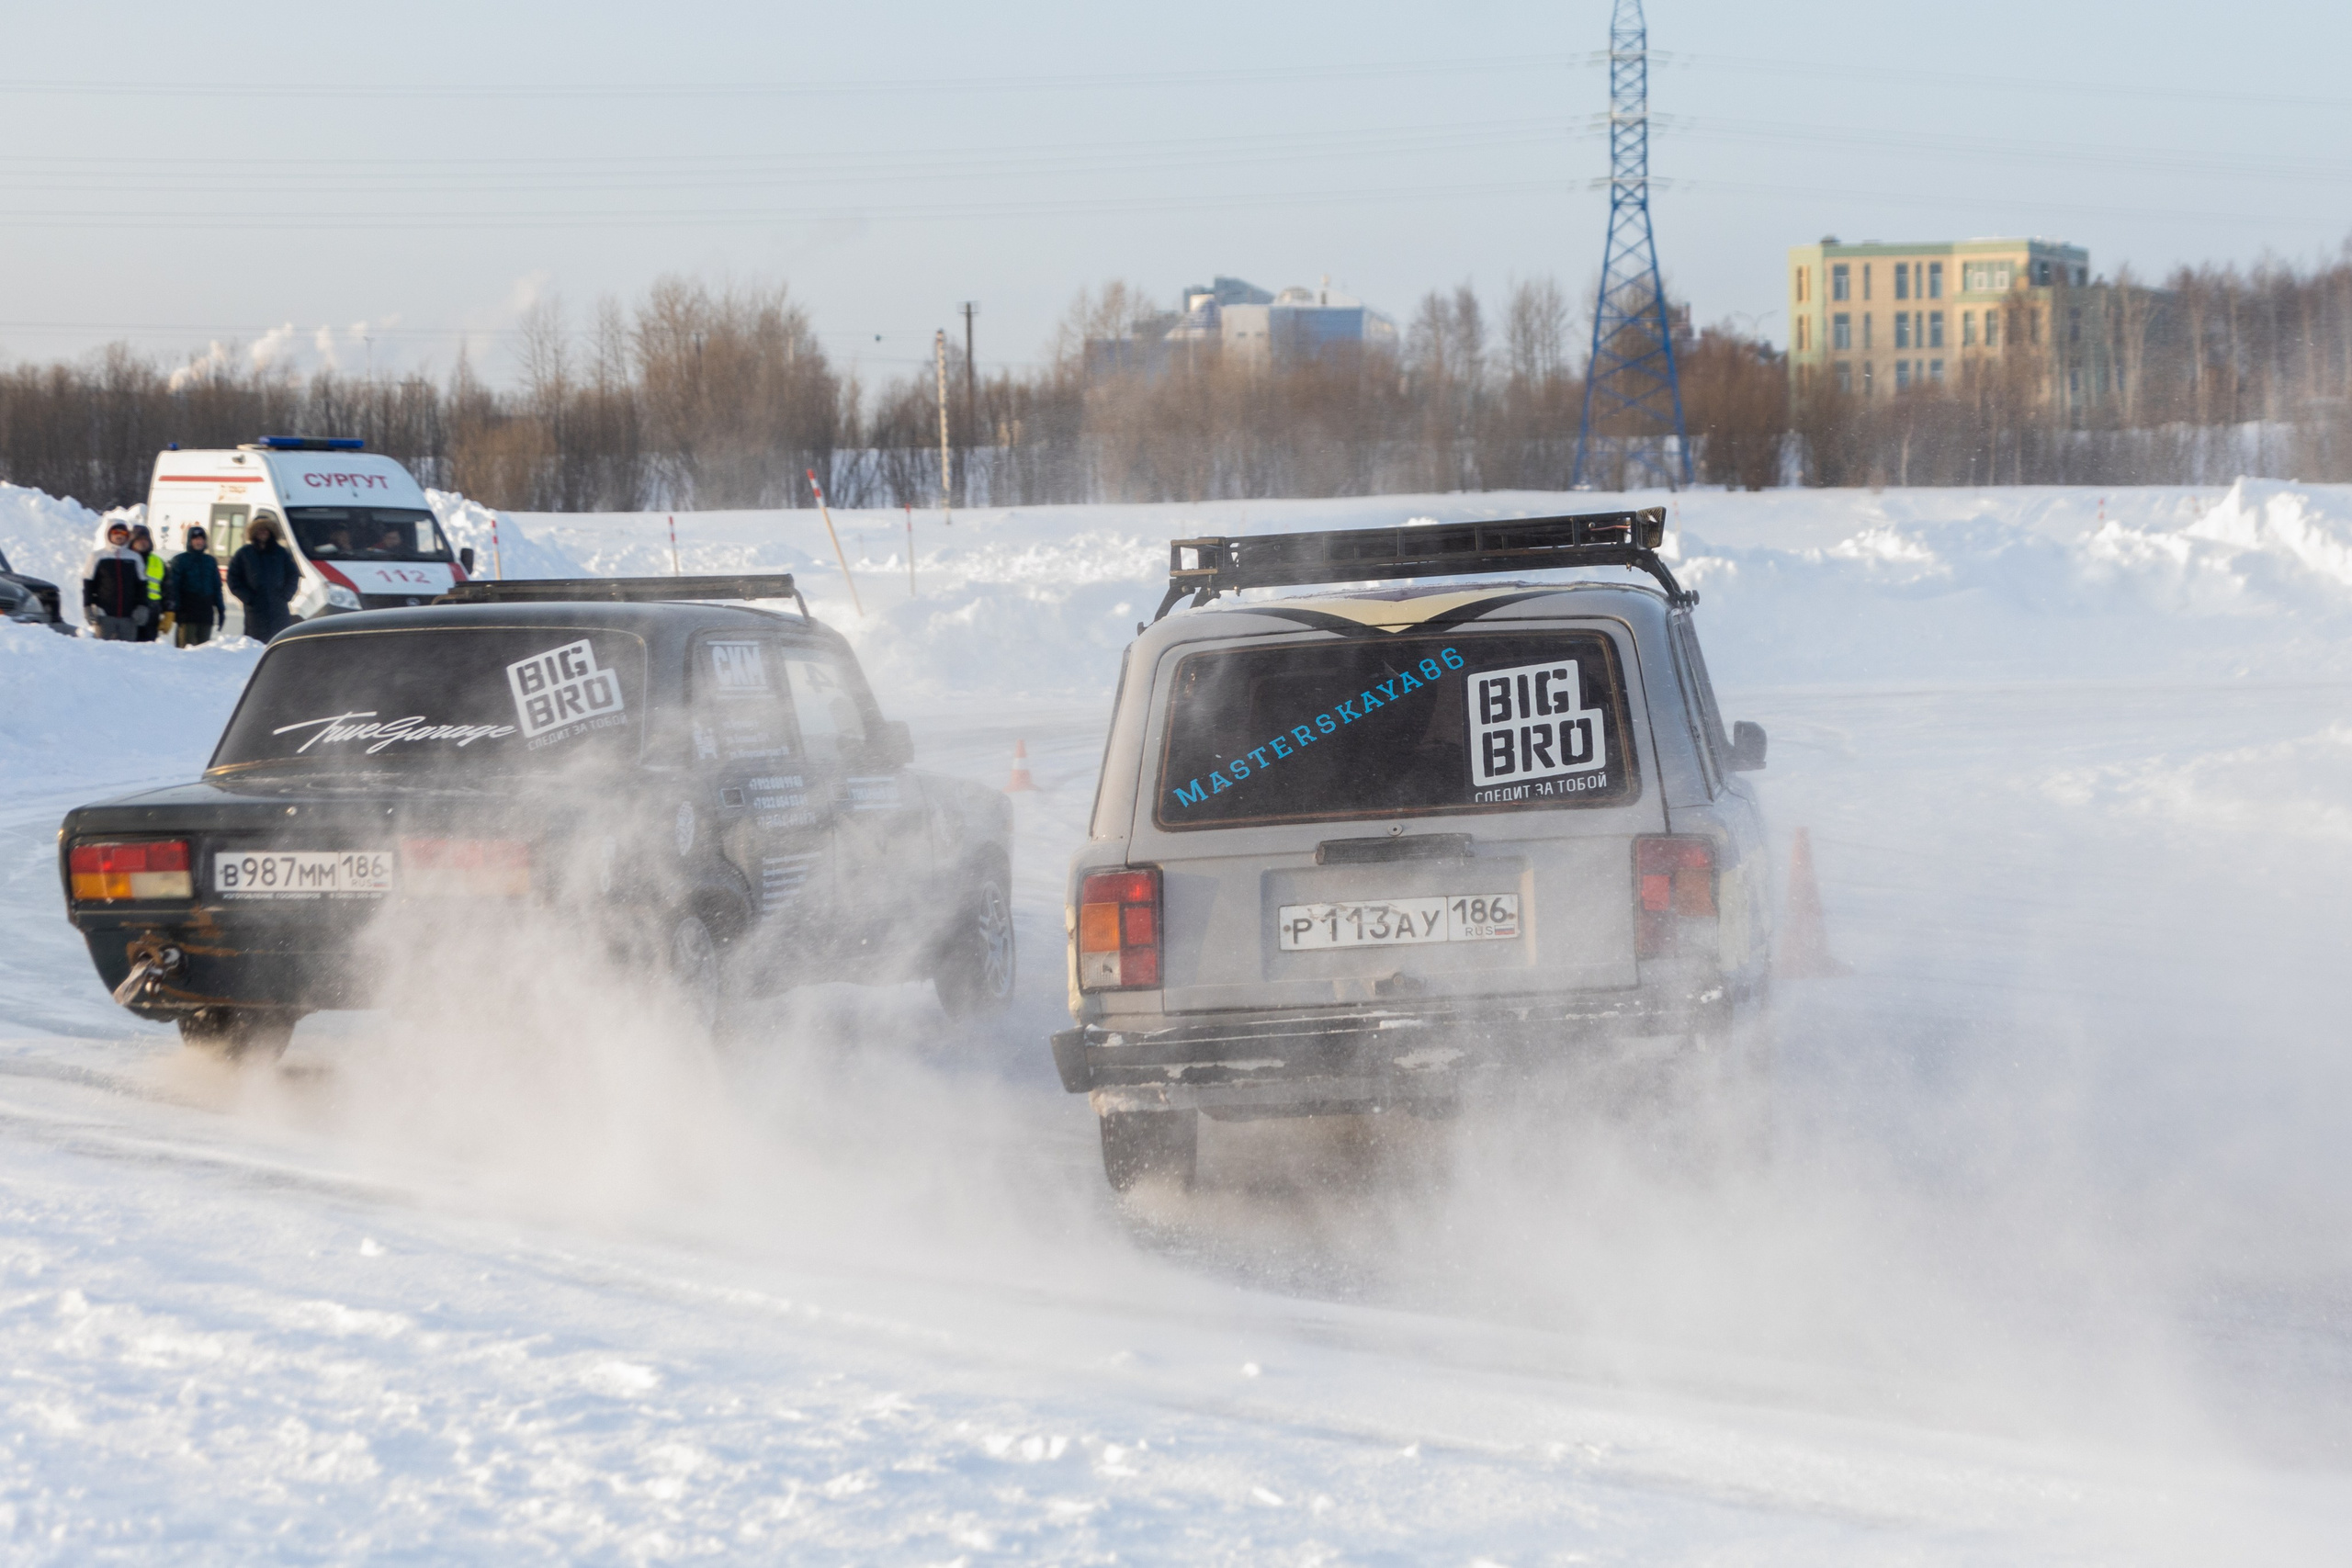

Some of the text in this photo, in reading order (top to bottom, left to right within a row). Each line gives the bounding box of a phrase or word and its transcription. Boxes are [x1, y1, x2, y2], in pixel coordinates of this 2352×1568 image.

[304, 472, 389, 491] СУРГУТ
[376, 569, 430, 584] 112
[515, 646, 589, 696] BIG
[525, 676, 615, 729] BRO
[1478, 668, 1569, 725] BIG
[273, 711, 517, 754] TrueGarage
[527, 728, 571, 750] СЛЕДИТ
[590, 713, 628, 731] ТОБОЙ
[1172, 647, 1464, 807] MASTERSKAYA86
[1482, 718, 1594, 778] BRO
[1535, 781, 1555, 797] ЗА
[1556, 772, 1608, 793] ТОБОЙ
[224, 855, 383, 886] В987ММ 186
[351, 879, 373, 887] RUS
[1292, 897, 1507, 944] Р113АУ 186
[1465, 925, 1494, 937] RUS
